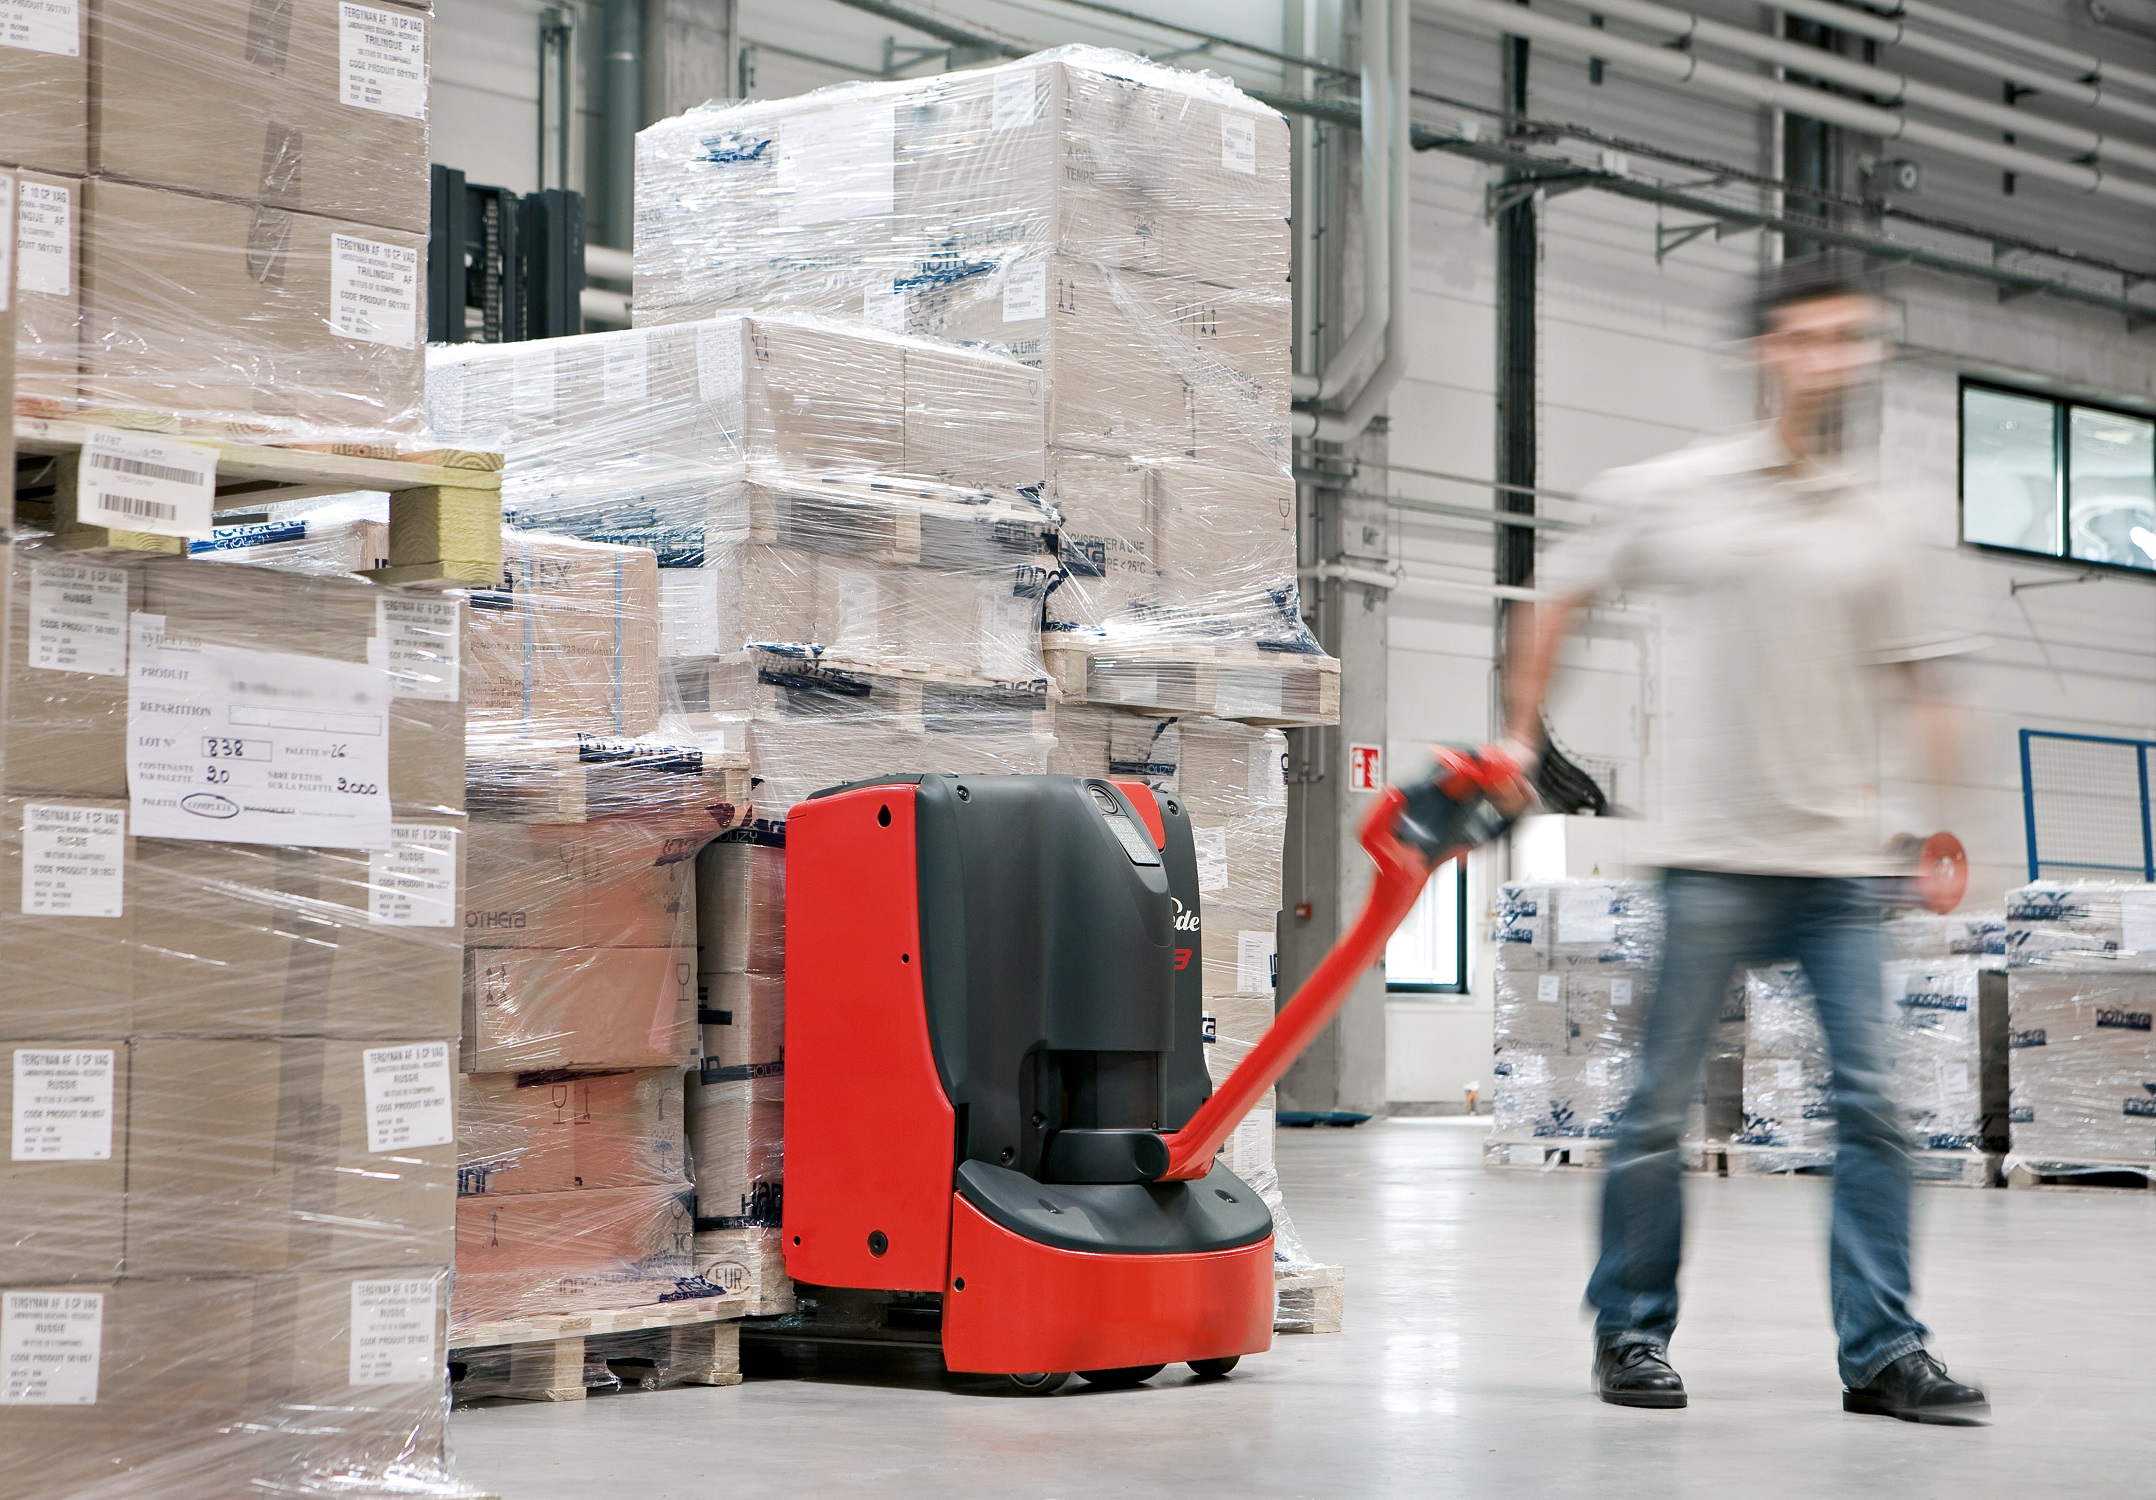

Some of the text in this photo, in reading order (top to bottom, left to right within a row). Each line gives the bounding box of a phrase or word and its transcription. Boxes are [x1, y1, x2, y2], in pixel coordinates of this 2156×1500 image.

[344, 6, 422, 32] TERGYNAN AF 10 CP VAG
[365, 34, 420, 53] TRILINGUE AF
[349, 59, 419, 81] CODE PRODUIT 501767
[30, 187, 66, 203] 10 CP VAG
[54, 216, 65, 226] AF
[17, 240, 36, 250] DUIT
[336, 238, 415, 263] TERGYNAN AF 10 CP VAG
[357, 266, 412, 284] TRILINGUE AF
[340, 290, 410, 311] CODE PRODUIT 501767
[1012, 340, 1041, 355] A UNE
[1120, 542, 1126, 552] A
[1127, 542, 1145, 554] UNE
[1127, 560, 1146, 574] 25°C
[63, 592, 93, 605] RUSSIE
[40, 619, 59, 630] CODE
[61, 621, 93, 633] PRODUIT
[141, 667, 189, 680] PRODUIT
[499, 676, 513, 686] This
[140, 702, 212, 717] REPARTITION
[139, 736, 160, 748] LOT
[208, 739, 243, 757] 838
[285, 746, 319, 757] PALETTE
[331, 744, 347, 758] 26
[139, 762, 194, 773] CONTENANTS
[157, 773, 194, 783] PALETTE
[298, 784, 332, 792] PALETTE
[142, 798, 177, 807] PALETTE
[188, 801, 232, 812] COMPLETE
[720, 830, 758, 843] OUZY
[398, 852, 425, 862] RUSSIE
[33, 864, 53, 875] CODE
[56, 865, 88, 876] PRODUIT
[378, 878, 425, 889] CODE PRODUIT
[370, 1051, 402, 1064] TERGYNAN
[393, 1072, 420, 1084] RUSSIE
[376, 1102, 393, 1113] CODE
[394, 1100, 422, 1110] PRODUIT
[23, 1109, 42, 1120] CODE
[45, 1110, 78, 1119] PRODUIT
[715, 1268, 743, 1290] EUR
[10, 1297, 49, 1310] TERGYNAN
[51, 1297, 61, 1309] AF
[71, 1298, 81, 1309] CP
[83, 1298, 98, 1310] VAG
[380, 1307, 405, 1318] RUSSIE
[34, 1322, 66, 1334] RUSSIE
[360, 1337, 376, 1347] CODE
[378, 1335, 406, 1345] PRODUIT
[10, 1353, 30, 1364] CODE
[32, 1354, 64, 1364] PRODUIT
